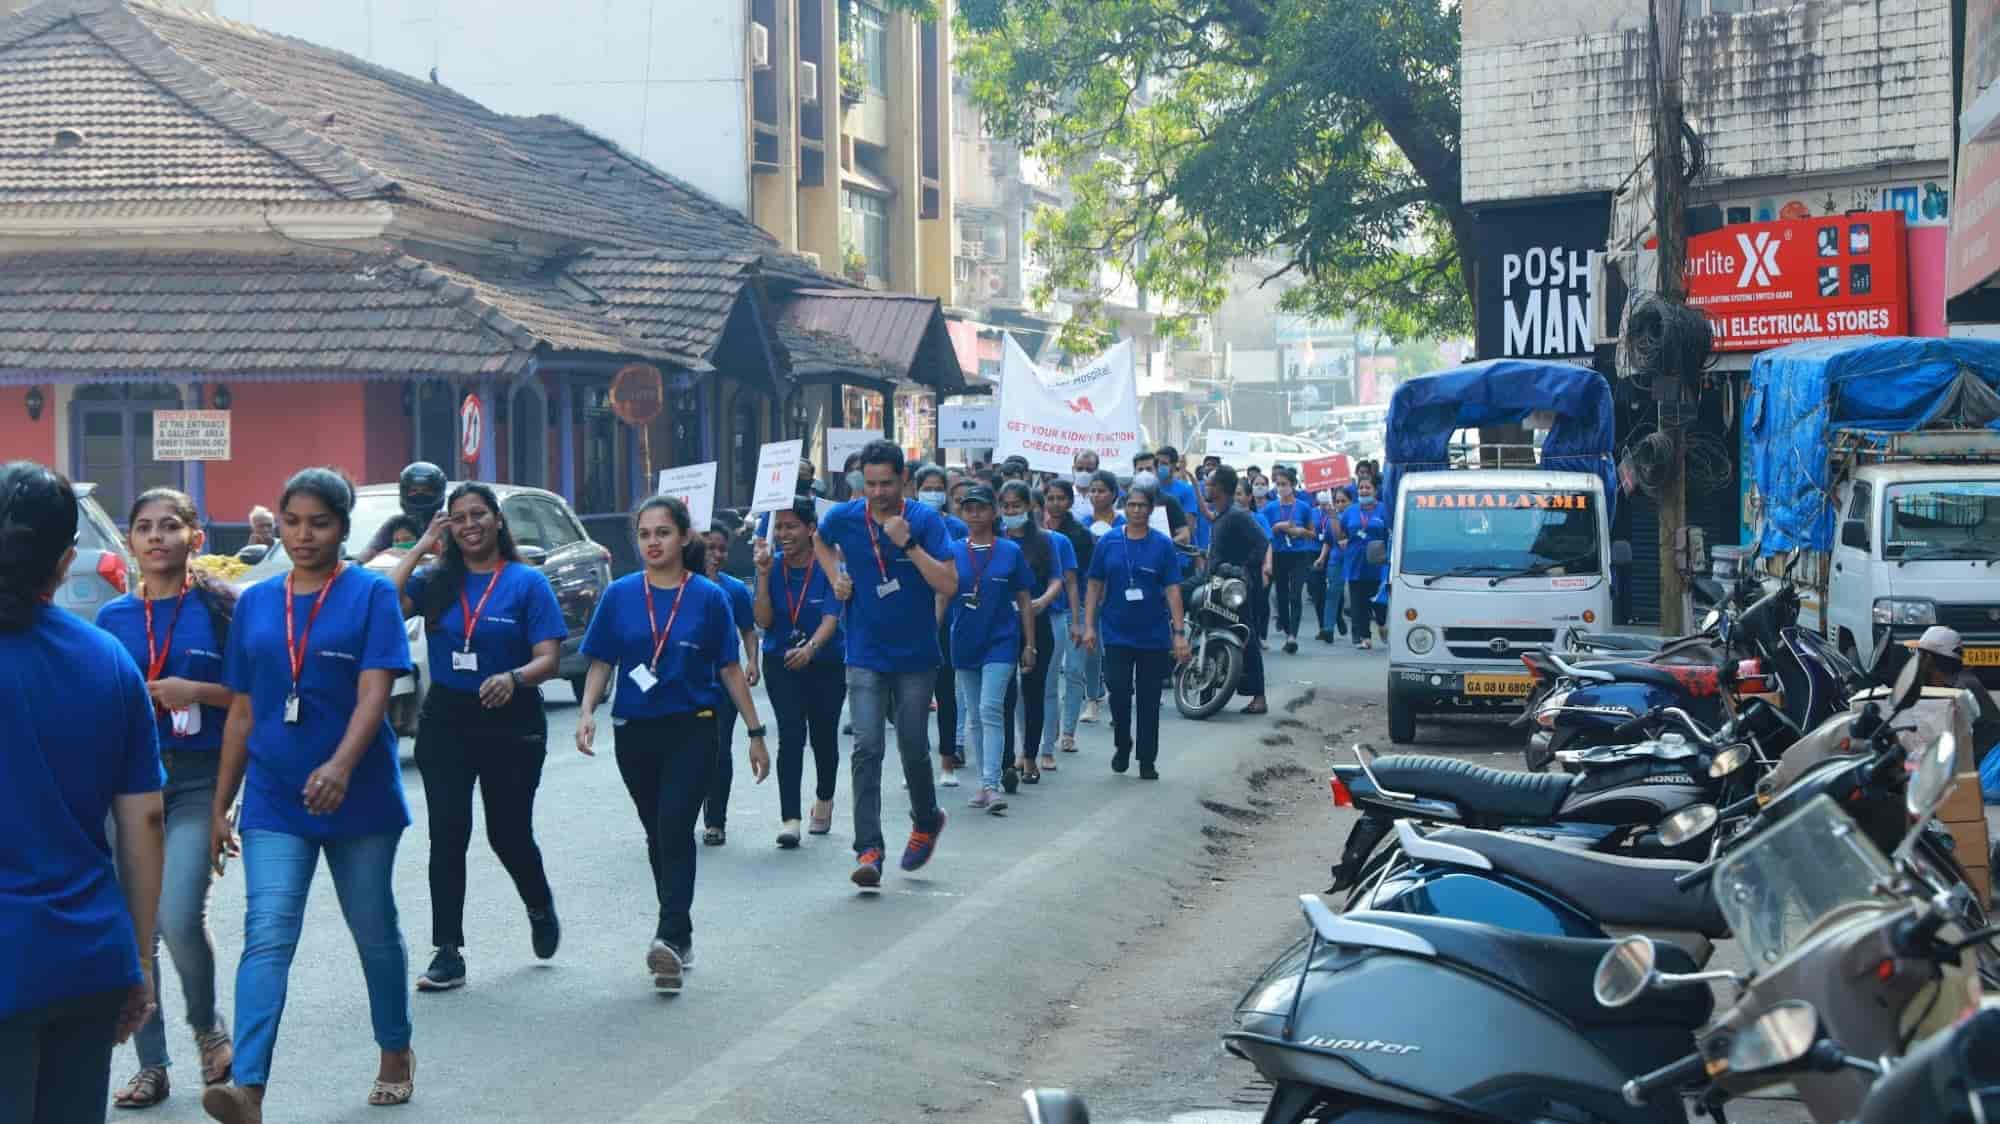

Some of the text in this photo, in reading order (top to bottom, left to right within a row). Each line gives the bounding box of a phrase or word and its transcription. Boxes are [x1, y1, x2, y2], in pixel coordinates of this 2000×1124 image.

[1503, 245, 1596, 297] POSH
[1503, 287, 1595, 356] MAN
[1731, 312, 1823, 337] ELECTRICAL
[1827, 308, 1890, 332] STORES
[1007, 421, 1027, 433] GET
[1031, 423, 1059, 437] YOUR
[1022, 439, 1071, 455] CHECKED
[1415, 494, 1588, 509] MAHALAXMI
[1467, 682, 1482, 694] GA
[1483, 682, 1497, 694] 08
[1498, 682, 1506, 694] U
[1643, 775, 1696, 785] HONDA
[1298, 1034, 1421, 1055] Jupiter
